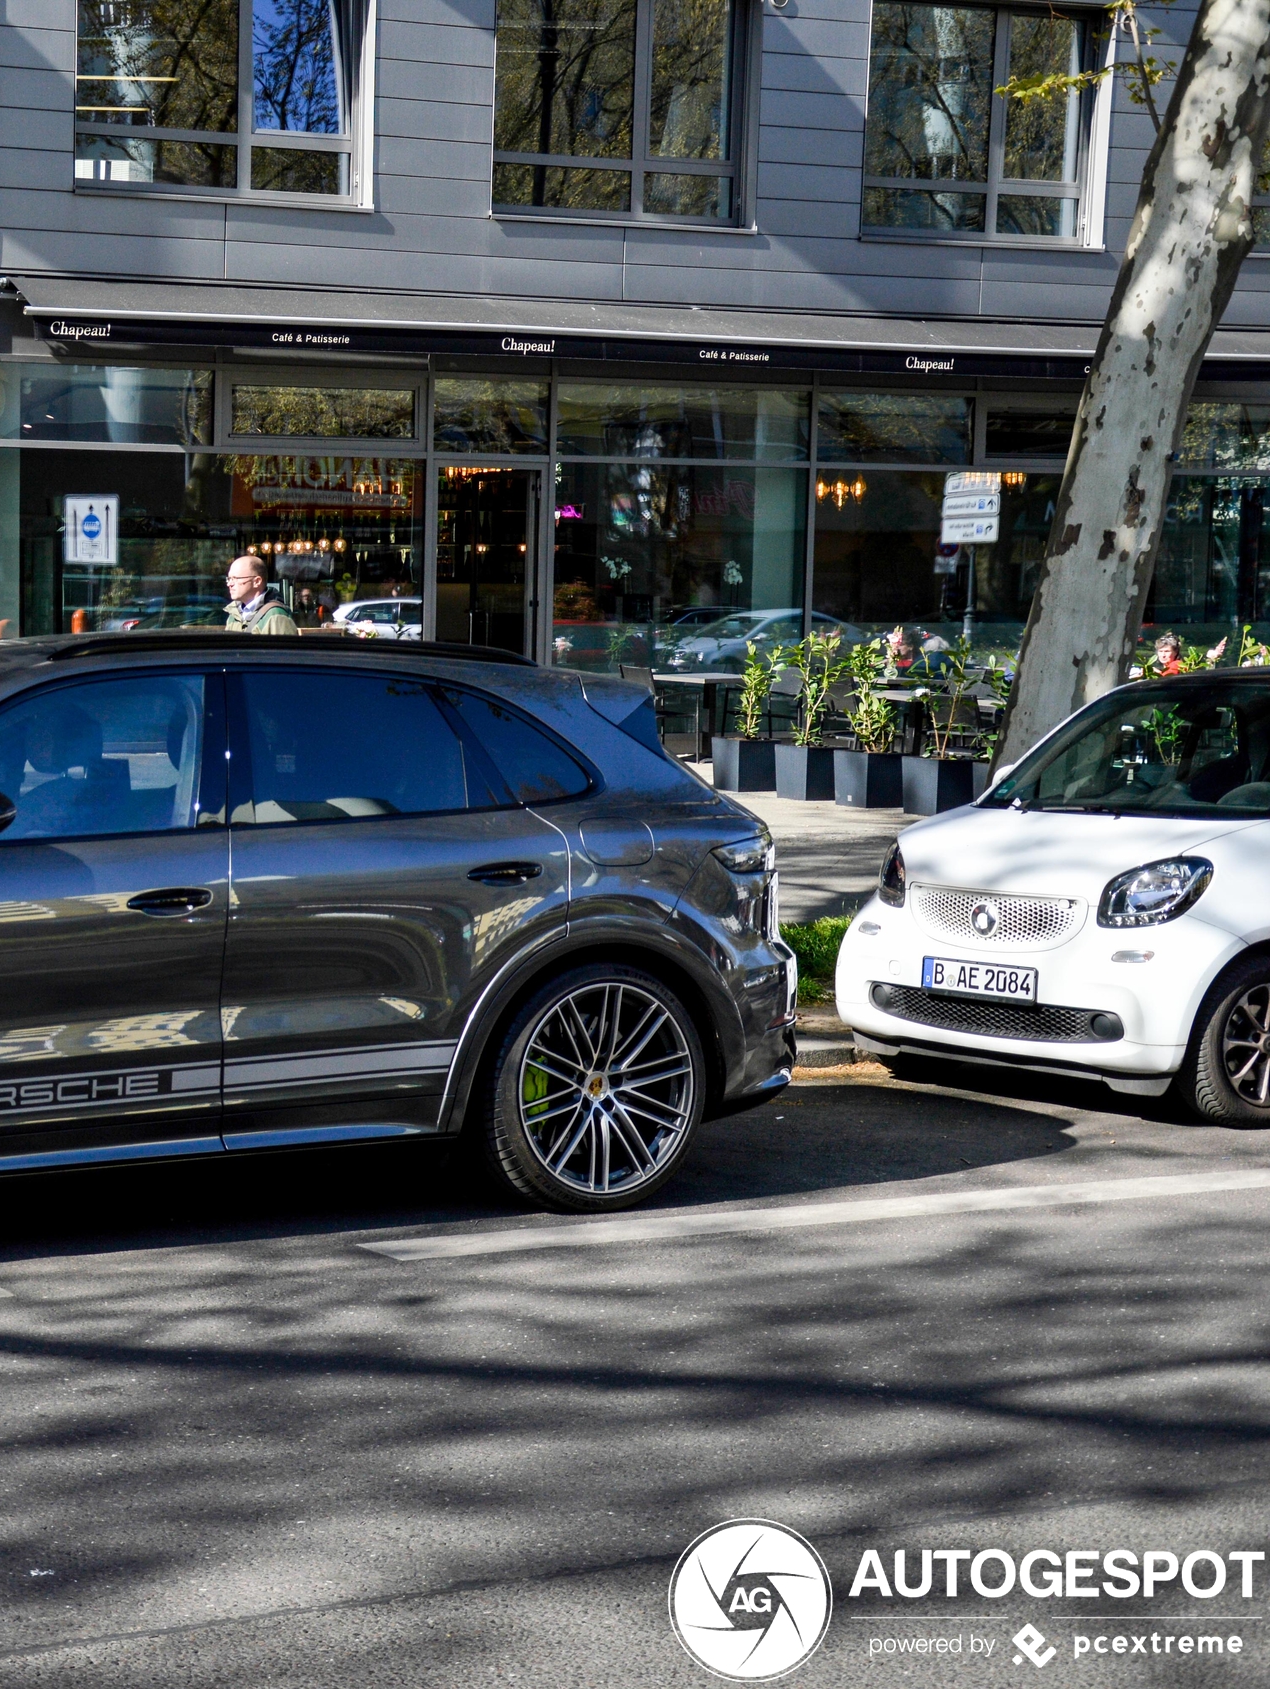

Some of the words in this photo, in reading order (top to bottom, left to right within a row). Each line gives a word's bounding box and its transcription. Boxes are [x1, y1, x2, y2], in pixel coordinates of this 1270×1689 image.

[50, 320, 111, 340] Chapeau!
[272, 332, 293, 342] Café
[296, 334, 303, 342] &
[305, 334, 350, 344] Patisserie
[501, 337, 555, 356] Chapeau!
[699, 350, 718, 360] Café
[720, 351, 727, 360] &
[729, 351, 770, 362] Patisserie
[905, 356, 955, 373] Chapeau!
[934, 962, 945, 985] B
[956, 965, 980, 990] AE
[983, 968, 1031, 996] 2084
